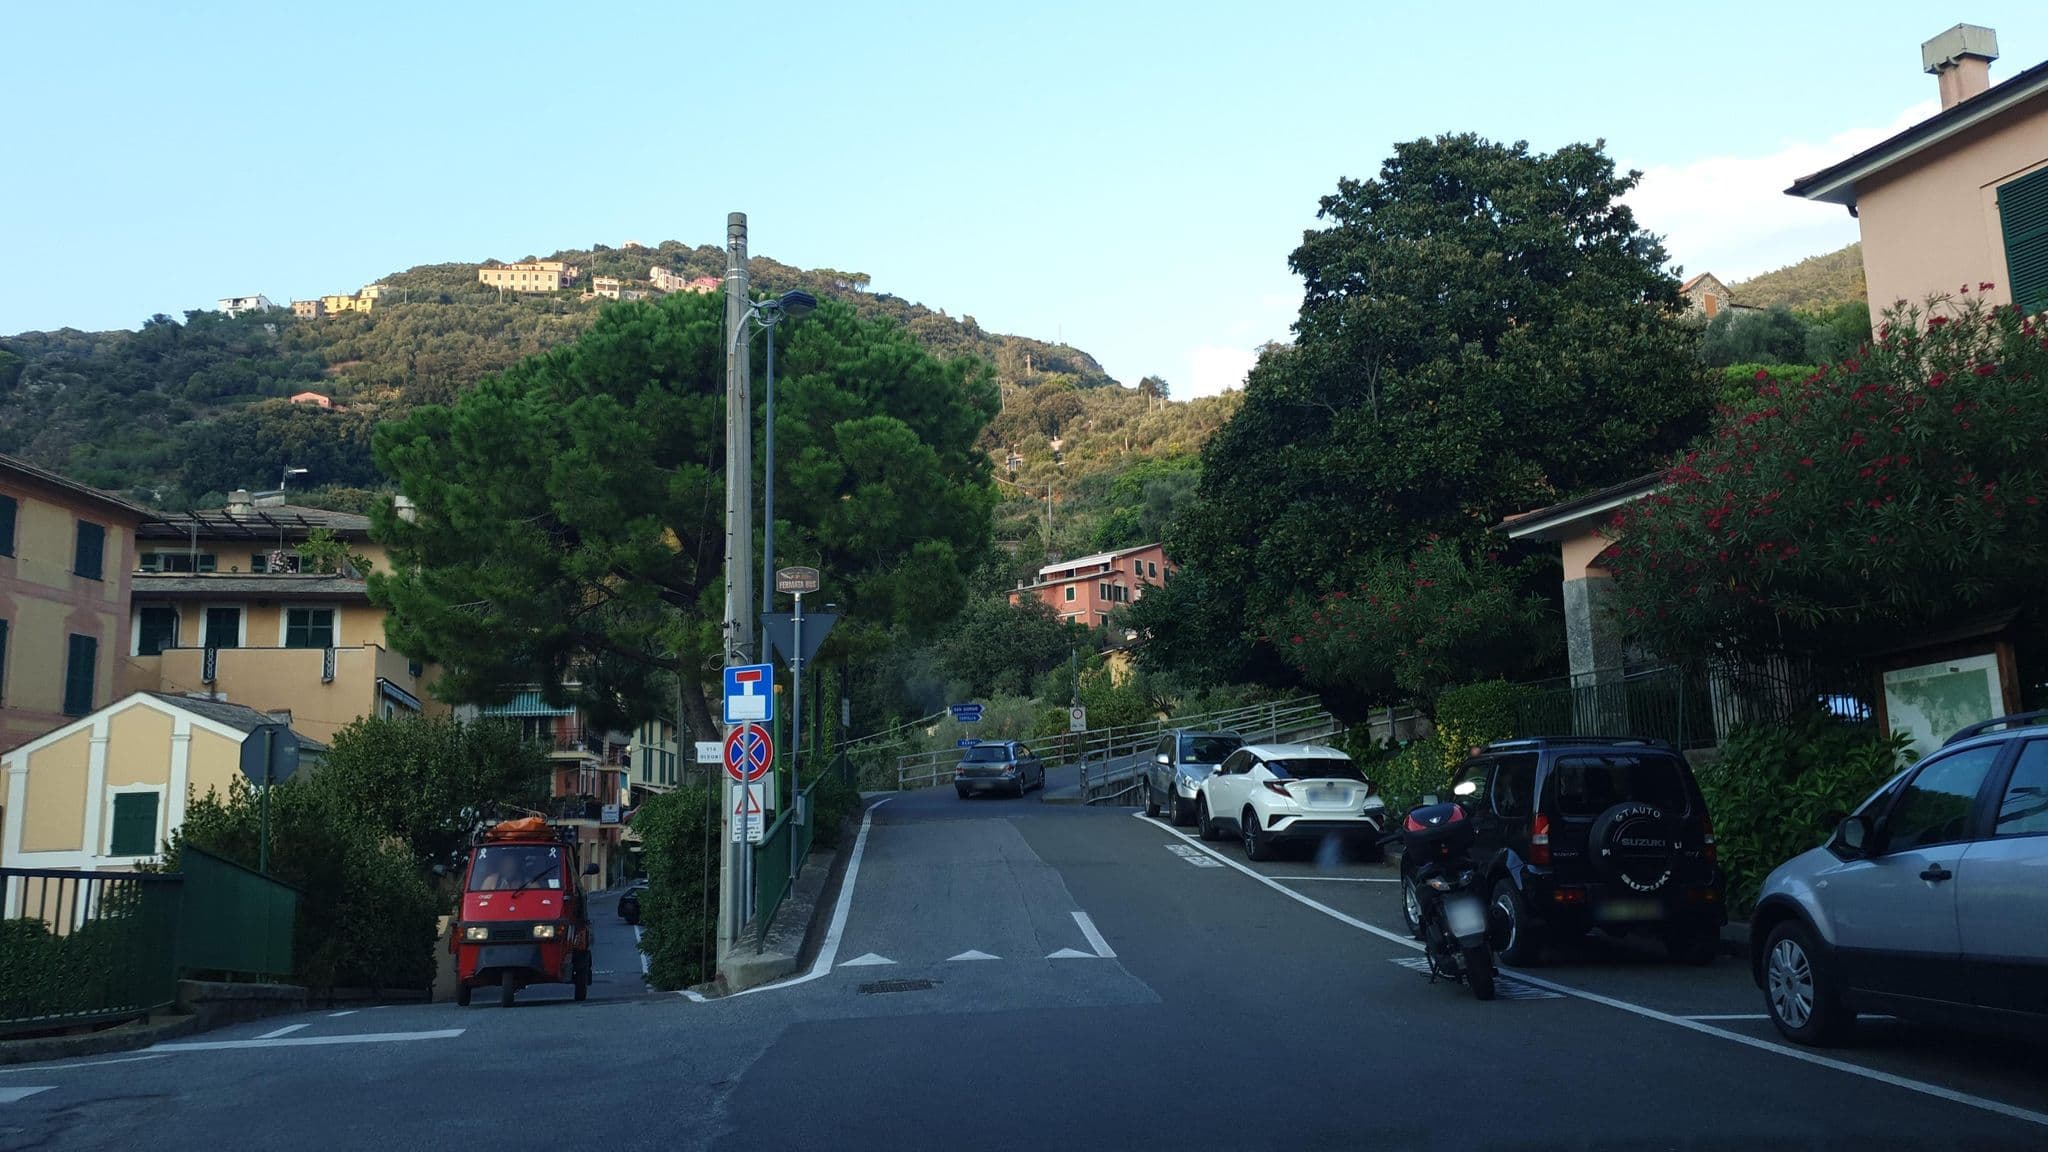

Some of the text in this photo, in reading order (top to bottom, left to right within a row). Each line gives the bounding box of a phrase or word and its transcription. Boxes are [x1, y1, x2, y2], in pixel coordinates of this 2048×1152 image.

[779, 580, 817, 589] FERMATA BUS
[1631, 806, 1661, 818] AUTO
[1621, 838, 1666, 847] SUZUKI
[1621, 870, 1671, 892] SUZUKI
